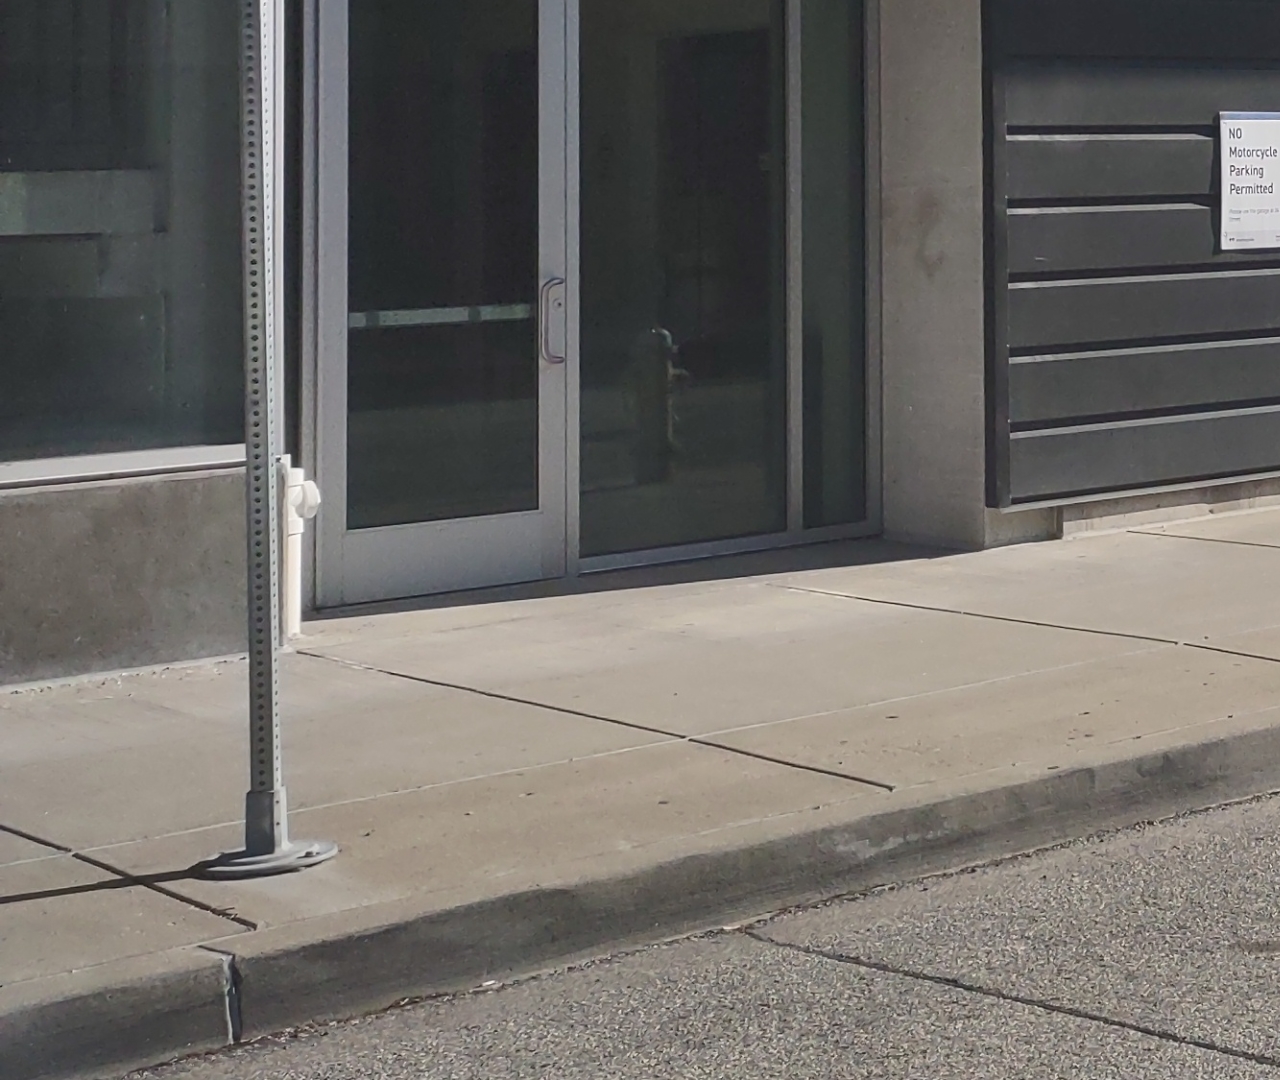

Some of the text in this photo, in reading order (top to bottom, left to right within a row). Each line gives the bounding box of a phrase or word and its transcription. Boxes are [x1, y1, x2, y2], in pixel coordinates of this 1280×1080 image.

[1228, 127, 1243, 139] NO
[1228, 146, 1278, 160] Motorcycle
[1229, 164, 1264, 179] Parking
[1229, 182, 1274, 195] Permitted
